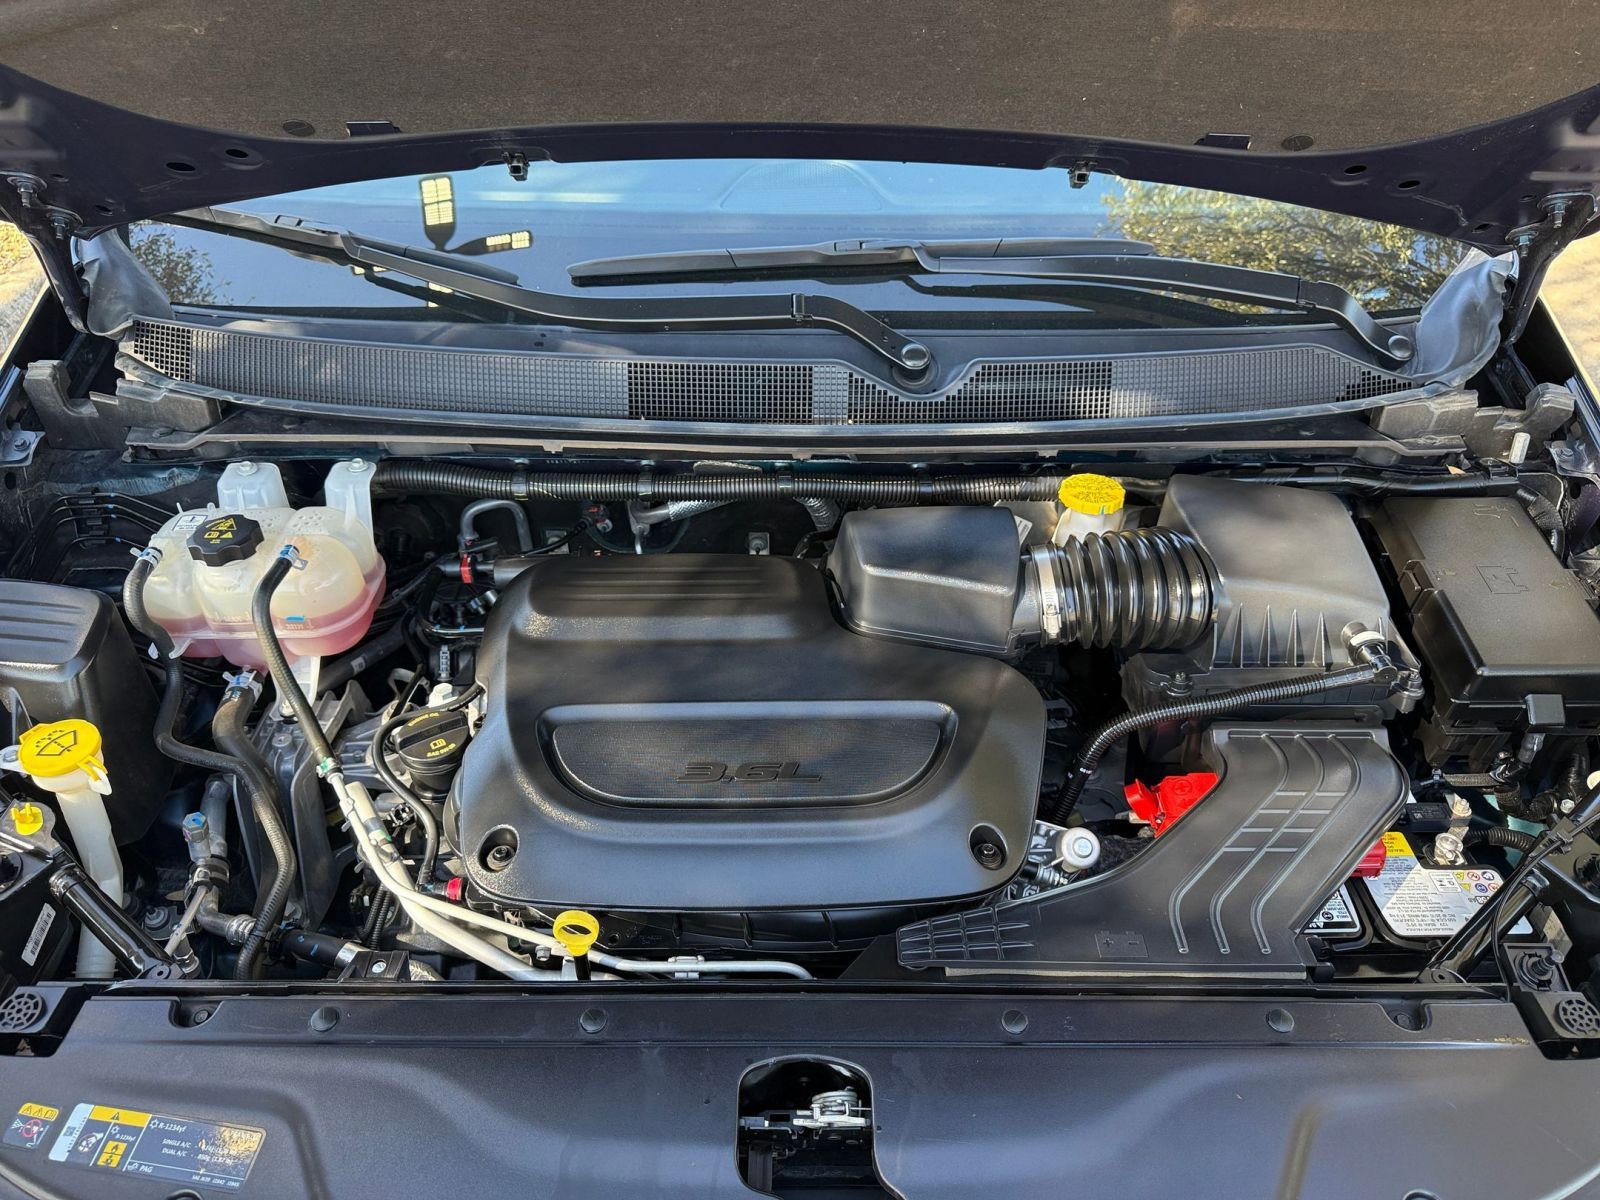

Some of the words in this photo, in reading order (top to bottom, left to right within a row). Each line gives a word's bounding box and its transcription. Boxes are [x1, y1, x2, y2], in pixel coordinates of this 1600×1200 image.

[677, 761, 822, 784] 3.6L
[158, 1122, 187, 1133] R-1234yf
[162, 1138, 181, 1147] SINGLE
[139, 1165, 153, 1173] PAG
